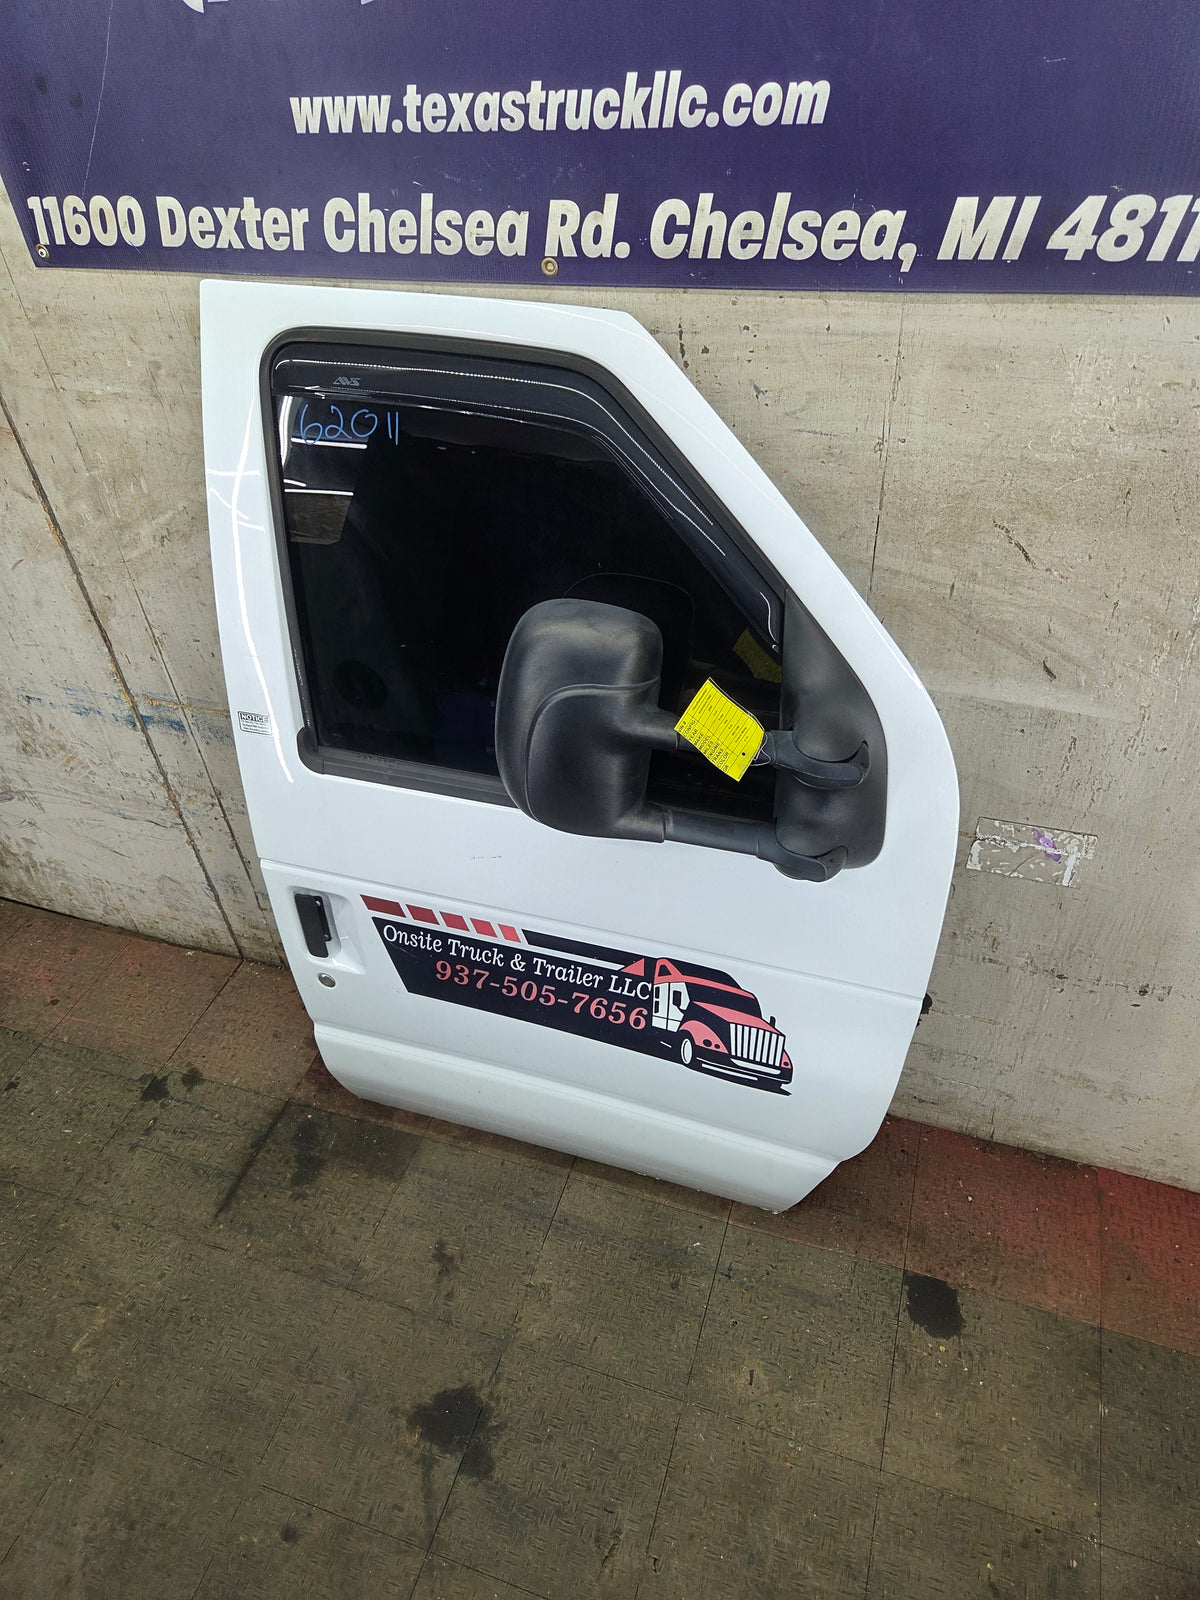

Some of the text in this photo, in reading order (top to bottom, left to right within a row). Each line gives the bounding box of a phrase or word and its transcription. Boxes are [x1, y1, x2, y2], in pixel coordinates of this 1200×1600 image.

[290, 69, 830, 134] www.texastruckllc.com
[28, 195, 146, 247] 11600
[156, 196, 309, 251] Dexter
[323, 192, 529, 256] Chelsea
[543, 193, 630, 259] Rd.
[650, 192, 907, 272] Chelsea,
[937, 195, 1041, 261] MI
[383, 924, 652, 1000] Onsite Truck & Trailer LLC
[435, 960, 649, 1030] 937-505-7656
